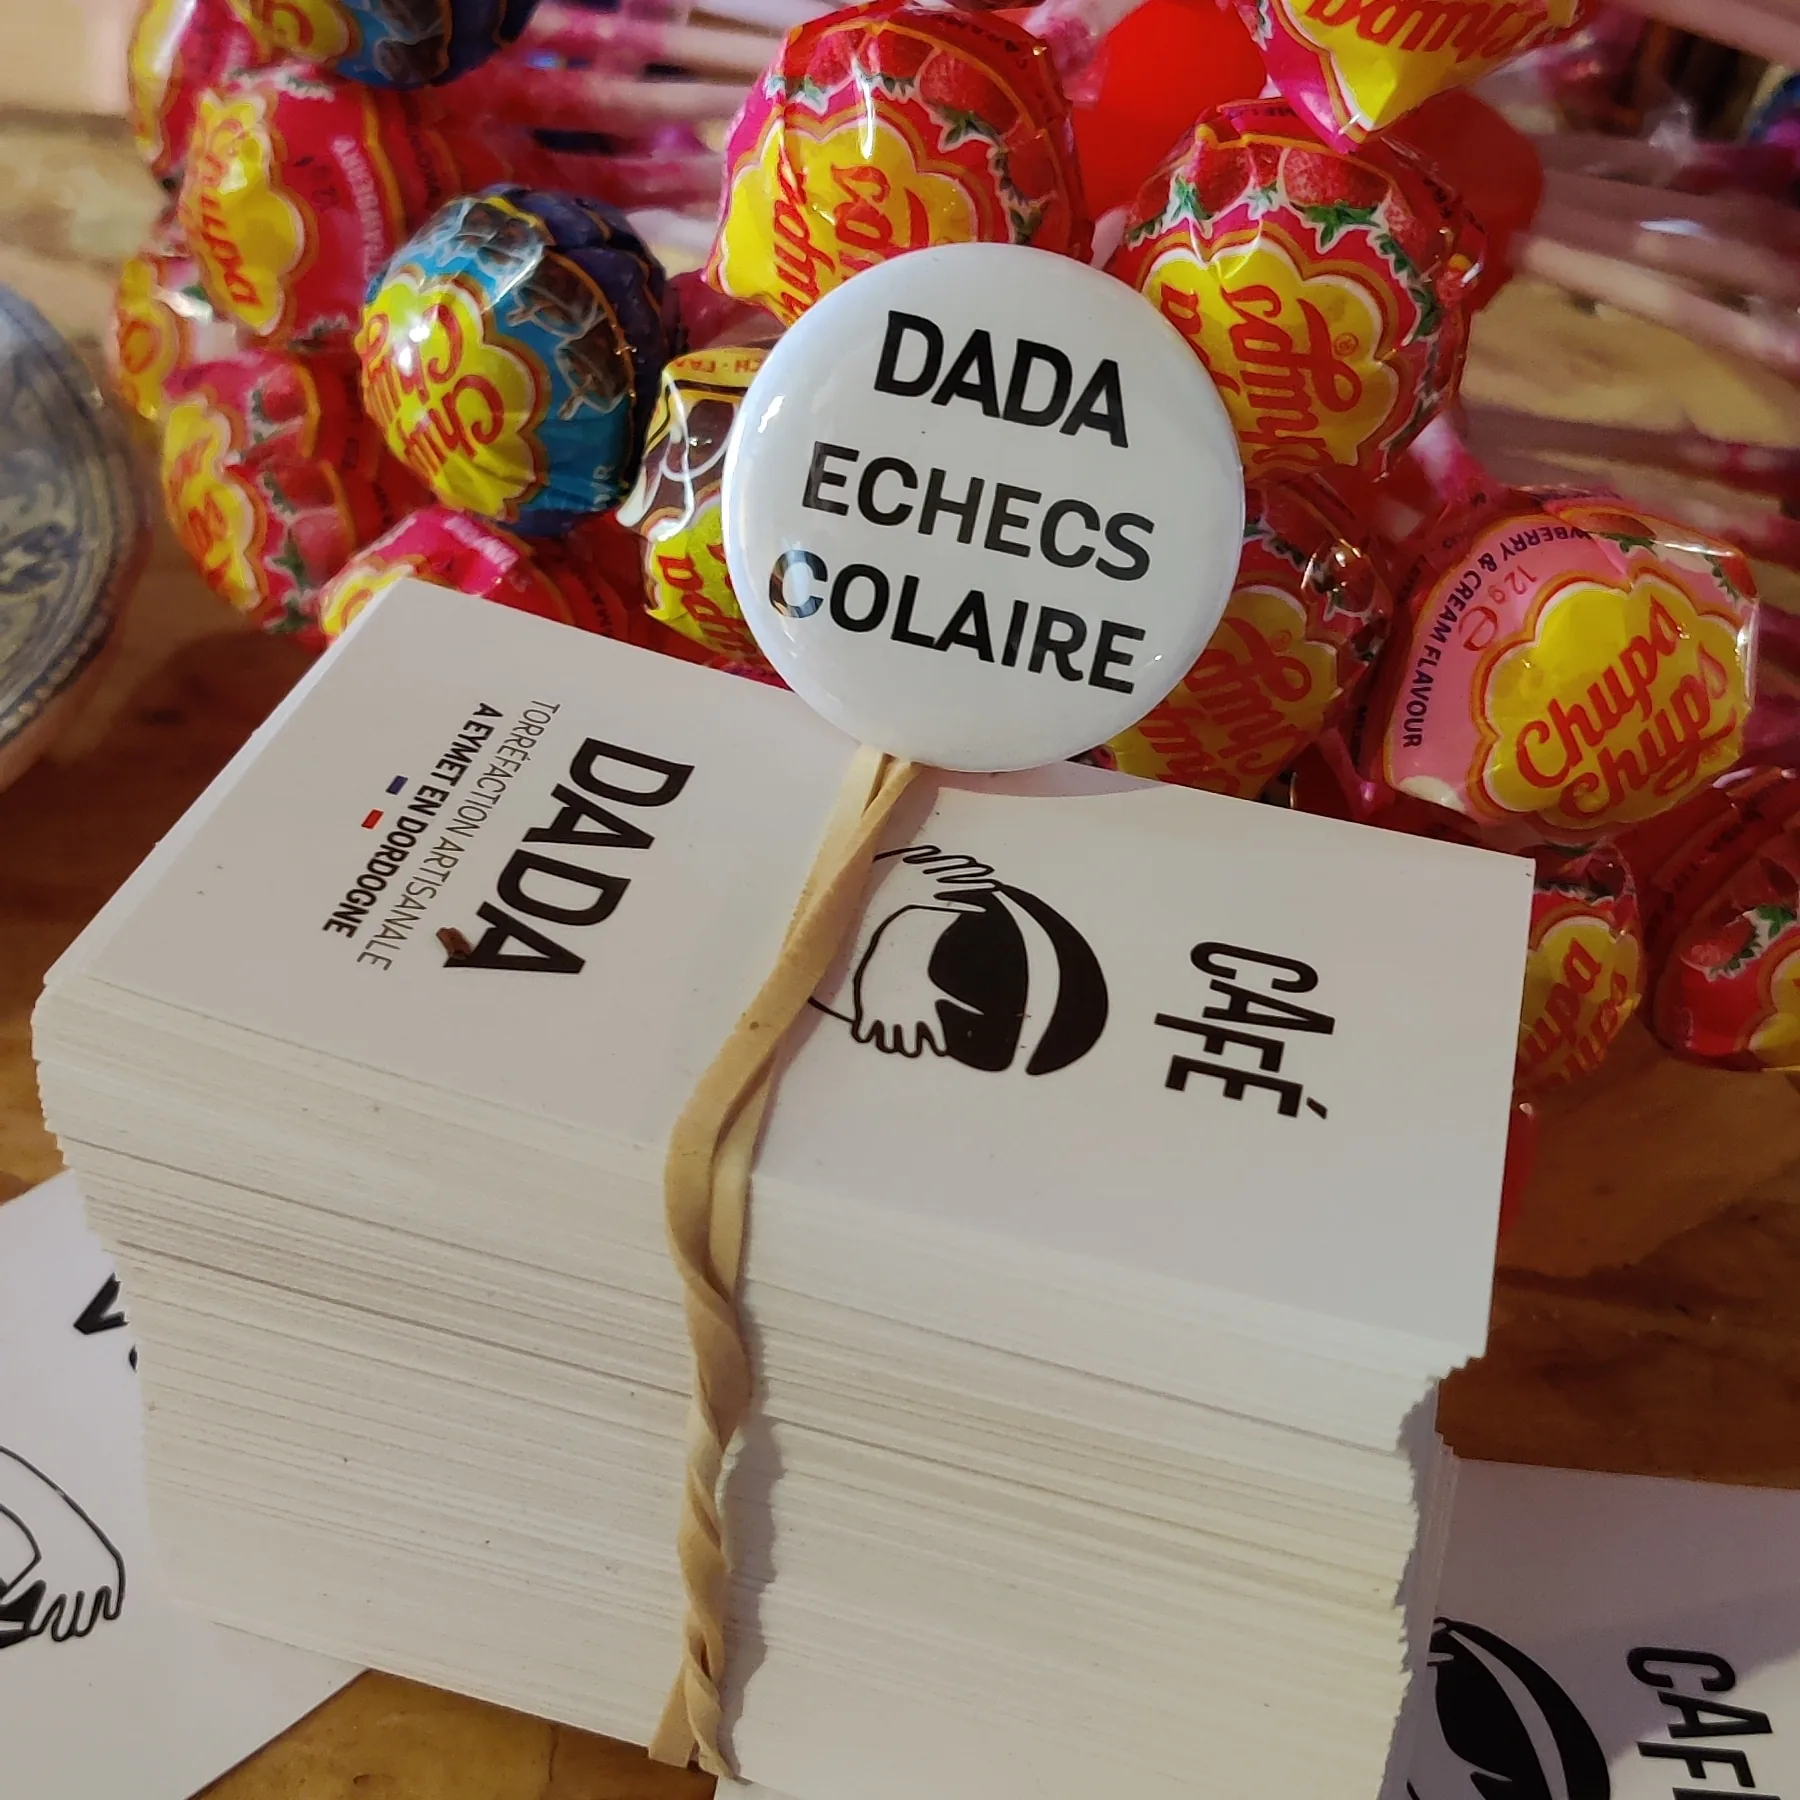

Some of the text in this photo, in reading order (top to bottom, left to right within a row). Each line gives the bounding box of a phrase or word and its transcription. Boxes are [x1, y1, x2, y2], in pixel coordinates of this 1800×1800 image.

[873, 309, 1130, 449] DADA
[802, 441, 1156, 581] ECHECS
[1477, 553, 1498, 572] &
[768, 548, 1147, 695] COLAIRE
[1436, 571, 1482, 644] CREAM
[430, 720, 495, 786] EYMET
[1402, 644, 1442, 748] FLAVOUR
[1559, 641, 1736, 819] Chups
[408, 785, 449, 815] EN
[446, 700, 560, 837] TORRÉFACTION
[322, 818, 427, 938] DORDOGNE
[357, 835, 465, 971] ARTISANALE
[443, 737, 694, 974] DADA
[1154, 941, 1336, 1120] CAFÉ
[1627, 1647, 1782, 1800] CAF
